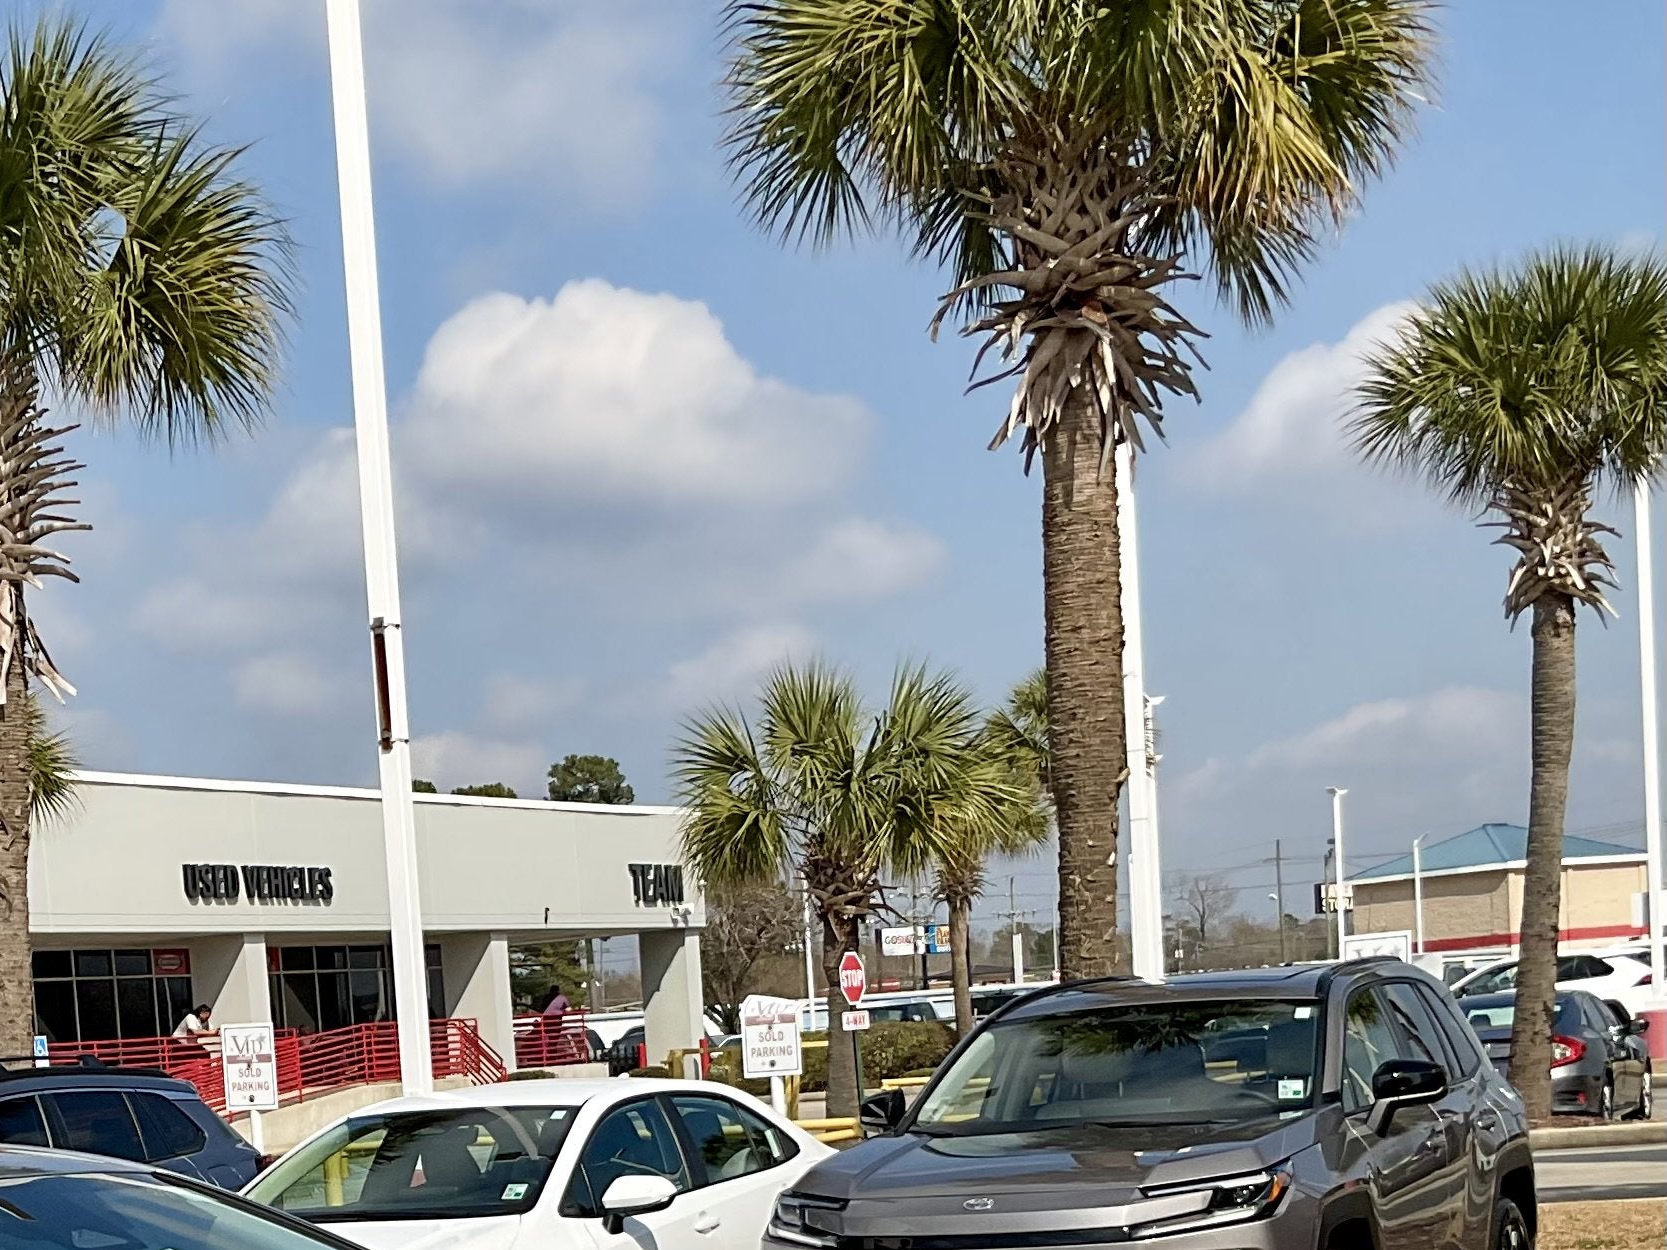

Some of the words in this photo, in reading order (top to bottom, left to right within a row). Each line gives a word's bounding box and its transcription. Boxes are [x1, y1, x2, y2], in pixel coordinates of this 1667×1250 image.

[182, 864, 239, 899] USED
[240, 865, 333, 900] VEHICLES
[628, 864, 684, 902] TEAM
[841, 969, 863, 989] STOP
[846, 1015, 866, 1027] 4-WAY
[758, 1031, 784, 1043] SOLD
[750, 1045, 793, 1058] PARKING
[238, 1067, 262, 1078] SOLD
[231, 1080, 270, 1092] PARKING
